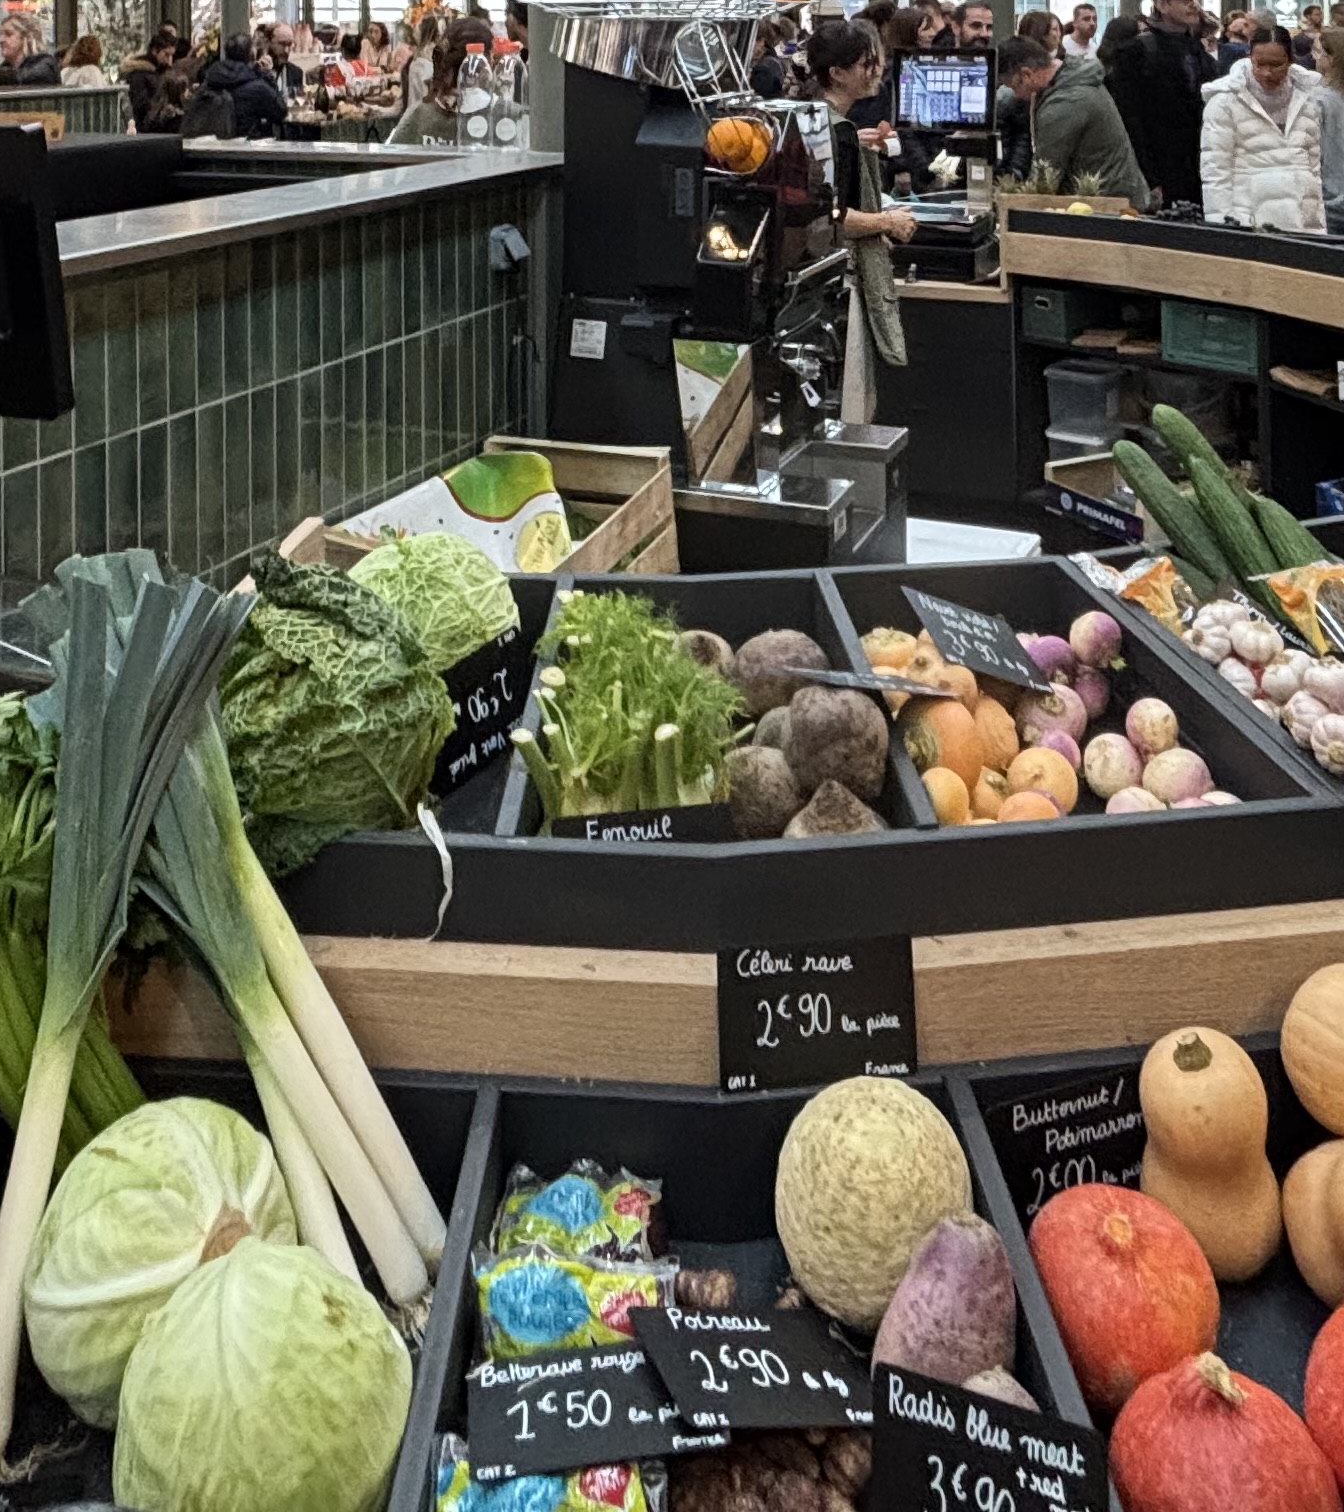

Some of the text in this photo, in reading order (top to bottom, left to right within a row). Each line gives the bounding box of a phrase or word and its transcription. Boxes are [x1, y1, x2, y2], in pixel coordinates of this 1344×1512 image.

[737, 948, 854, 978] Céleri rave
[757, 992, 831, 1048] 2€90
[666, 1307, 771, 1333] Poireau
[480, 1350, 646, 1388] Betterave rouge
[689, 1343, 790, 1393] 2€90
[506, 1389, 612, 1441] 1€50
[888, 1372, 1087, 1477] Radis blue meat
[1029, 1472, 1066, 1505] red
